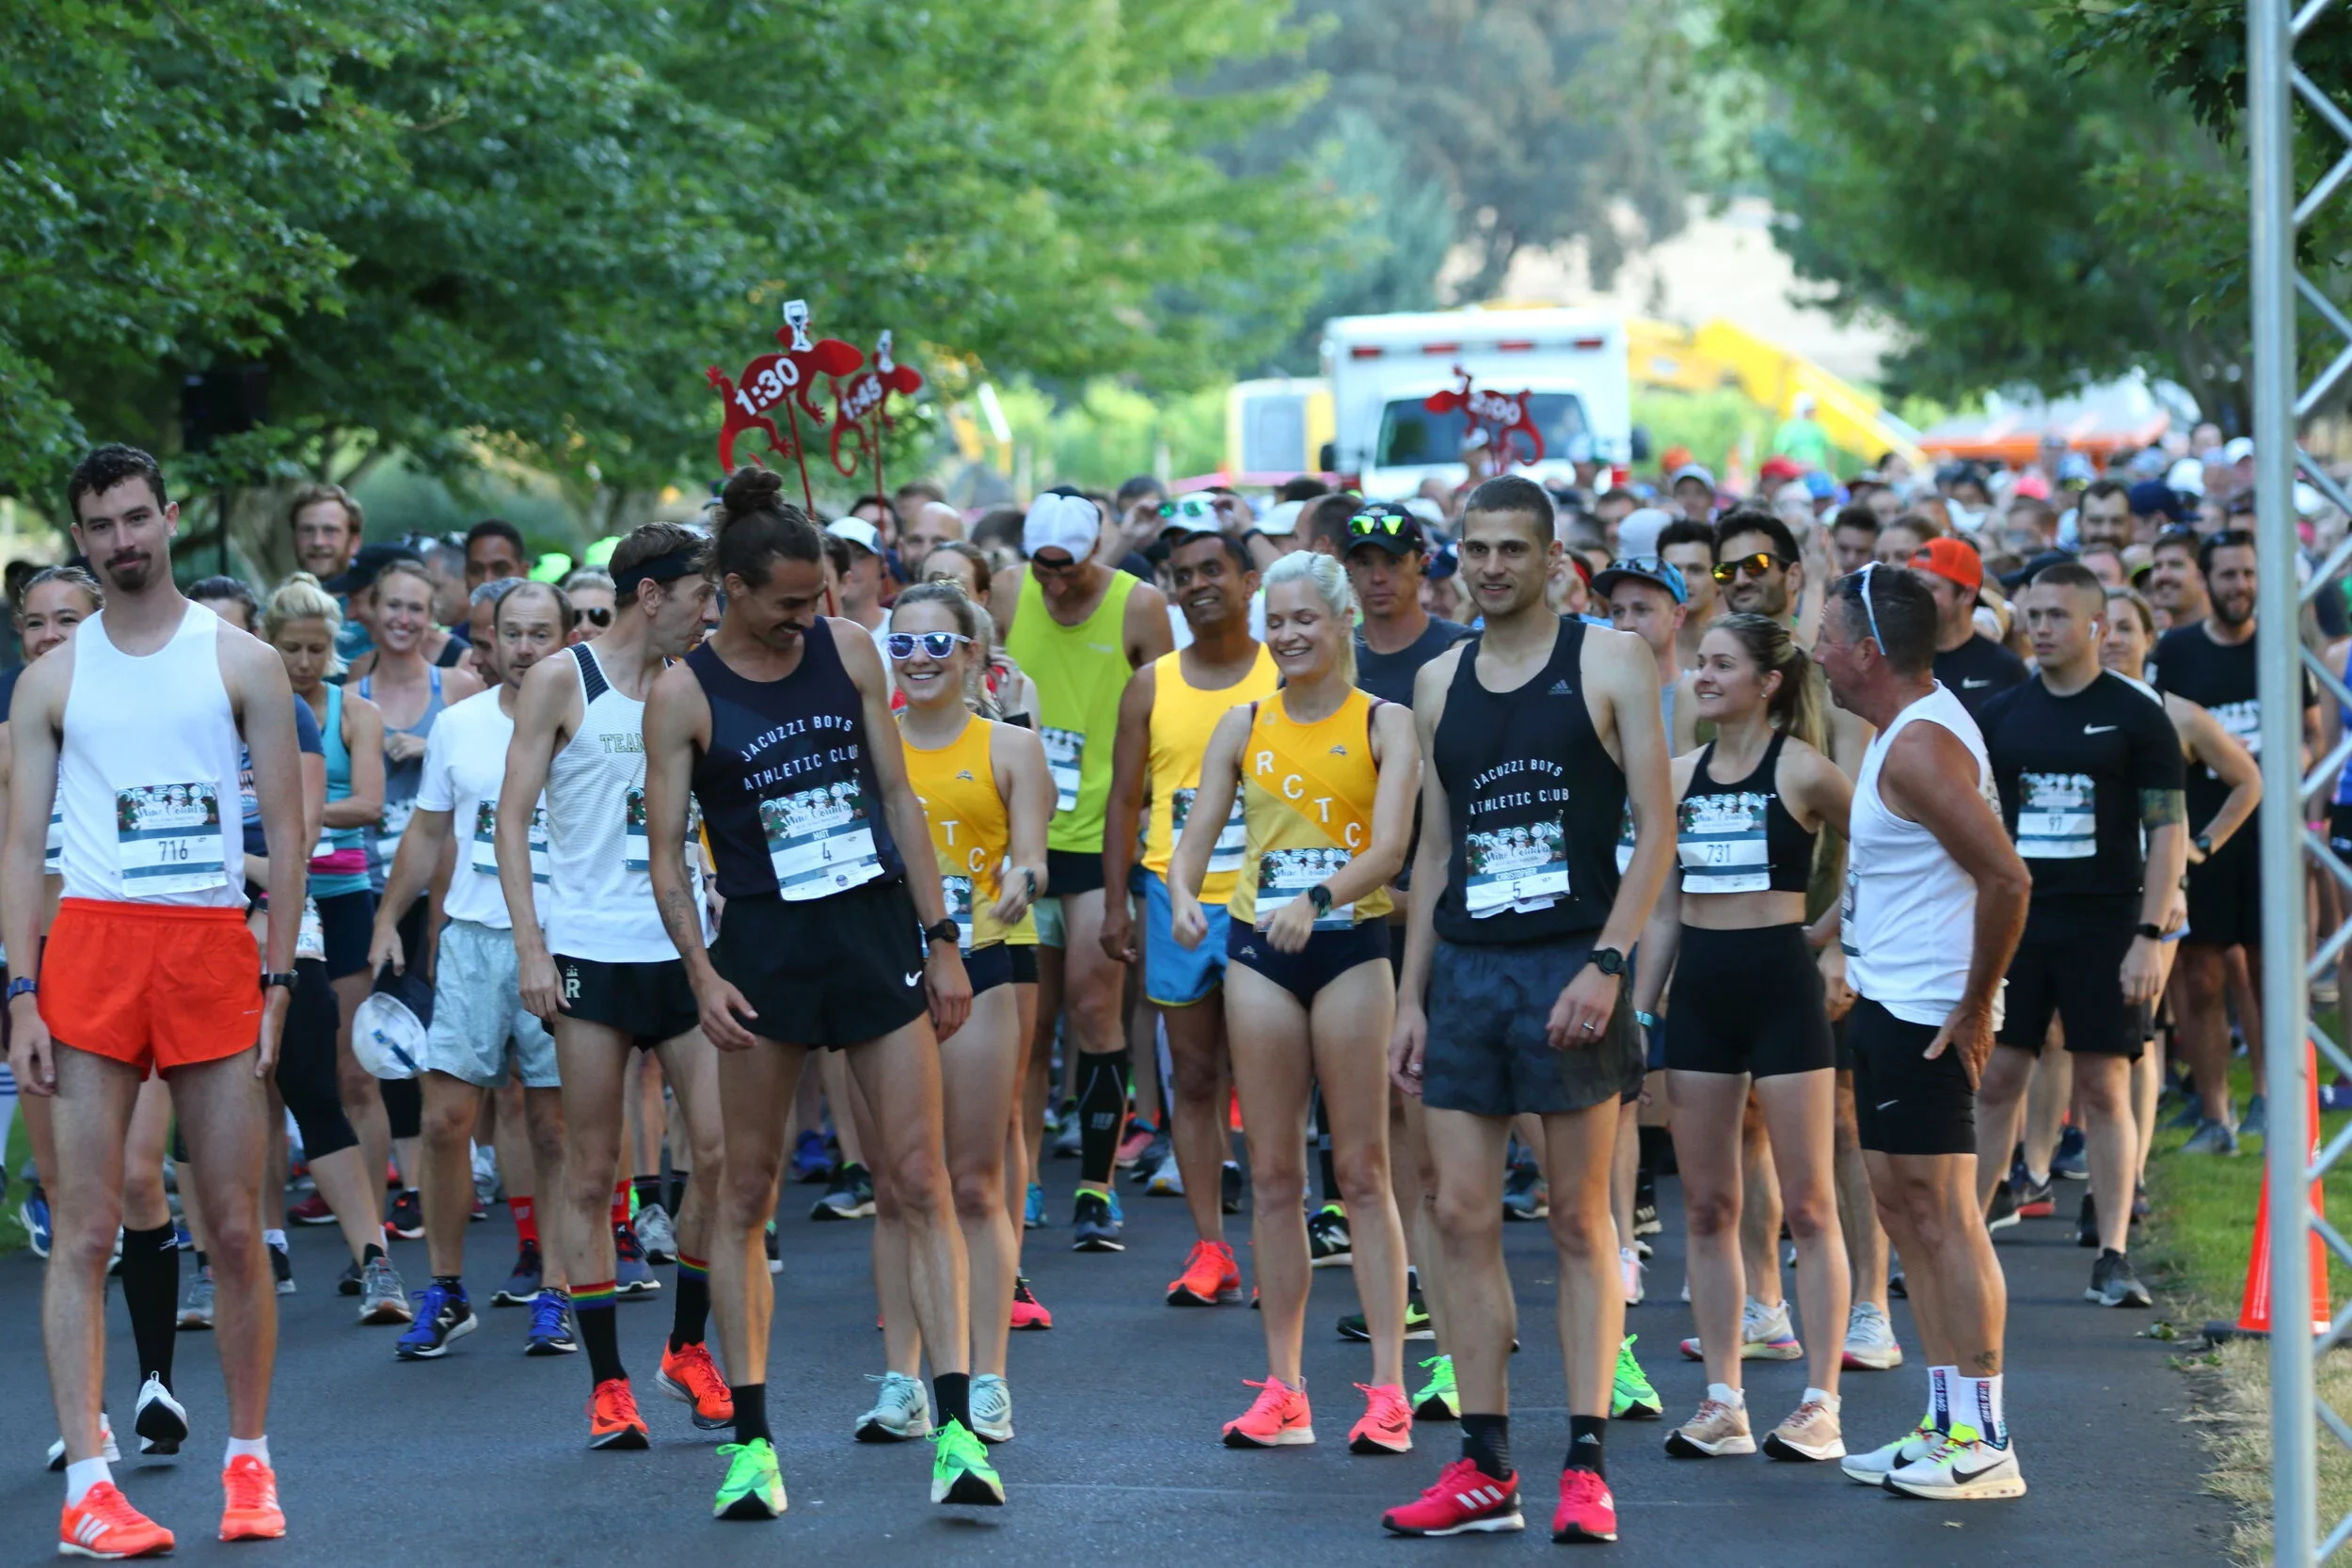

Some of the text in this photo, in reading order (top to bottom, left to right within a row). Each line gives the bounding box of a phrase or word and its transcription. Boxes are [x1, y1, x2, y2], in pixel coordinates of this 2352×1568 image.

[736, 357, 799, 416] 1:30
[841, 374, 882, 421] 1:45
[740, 715, 853, 763] JACUZZI BOYS
[743, 753, 822, 791] ATHLETIC
[1473, 758, 1564, 790] JACUZZI BOYS
[116, 783, 216, 803] OREGON
[759, 781, 860, 813] OREGON
[1469, 787, 1569, 816] ATHLETIC CLUB
[1684, 792, 1767, 810] OREGON
[1467, 821, 1563, 847] OREGON
[158, 839, 188, 862] 716
[822, 842, 832, 862] 4
[1706, 845, 1731, 863] 731
[1513, 881, 1520, 899] 5
[565, 978, 581, 998] R
